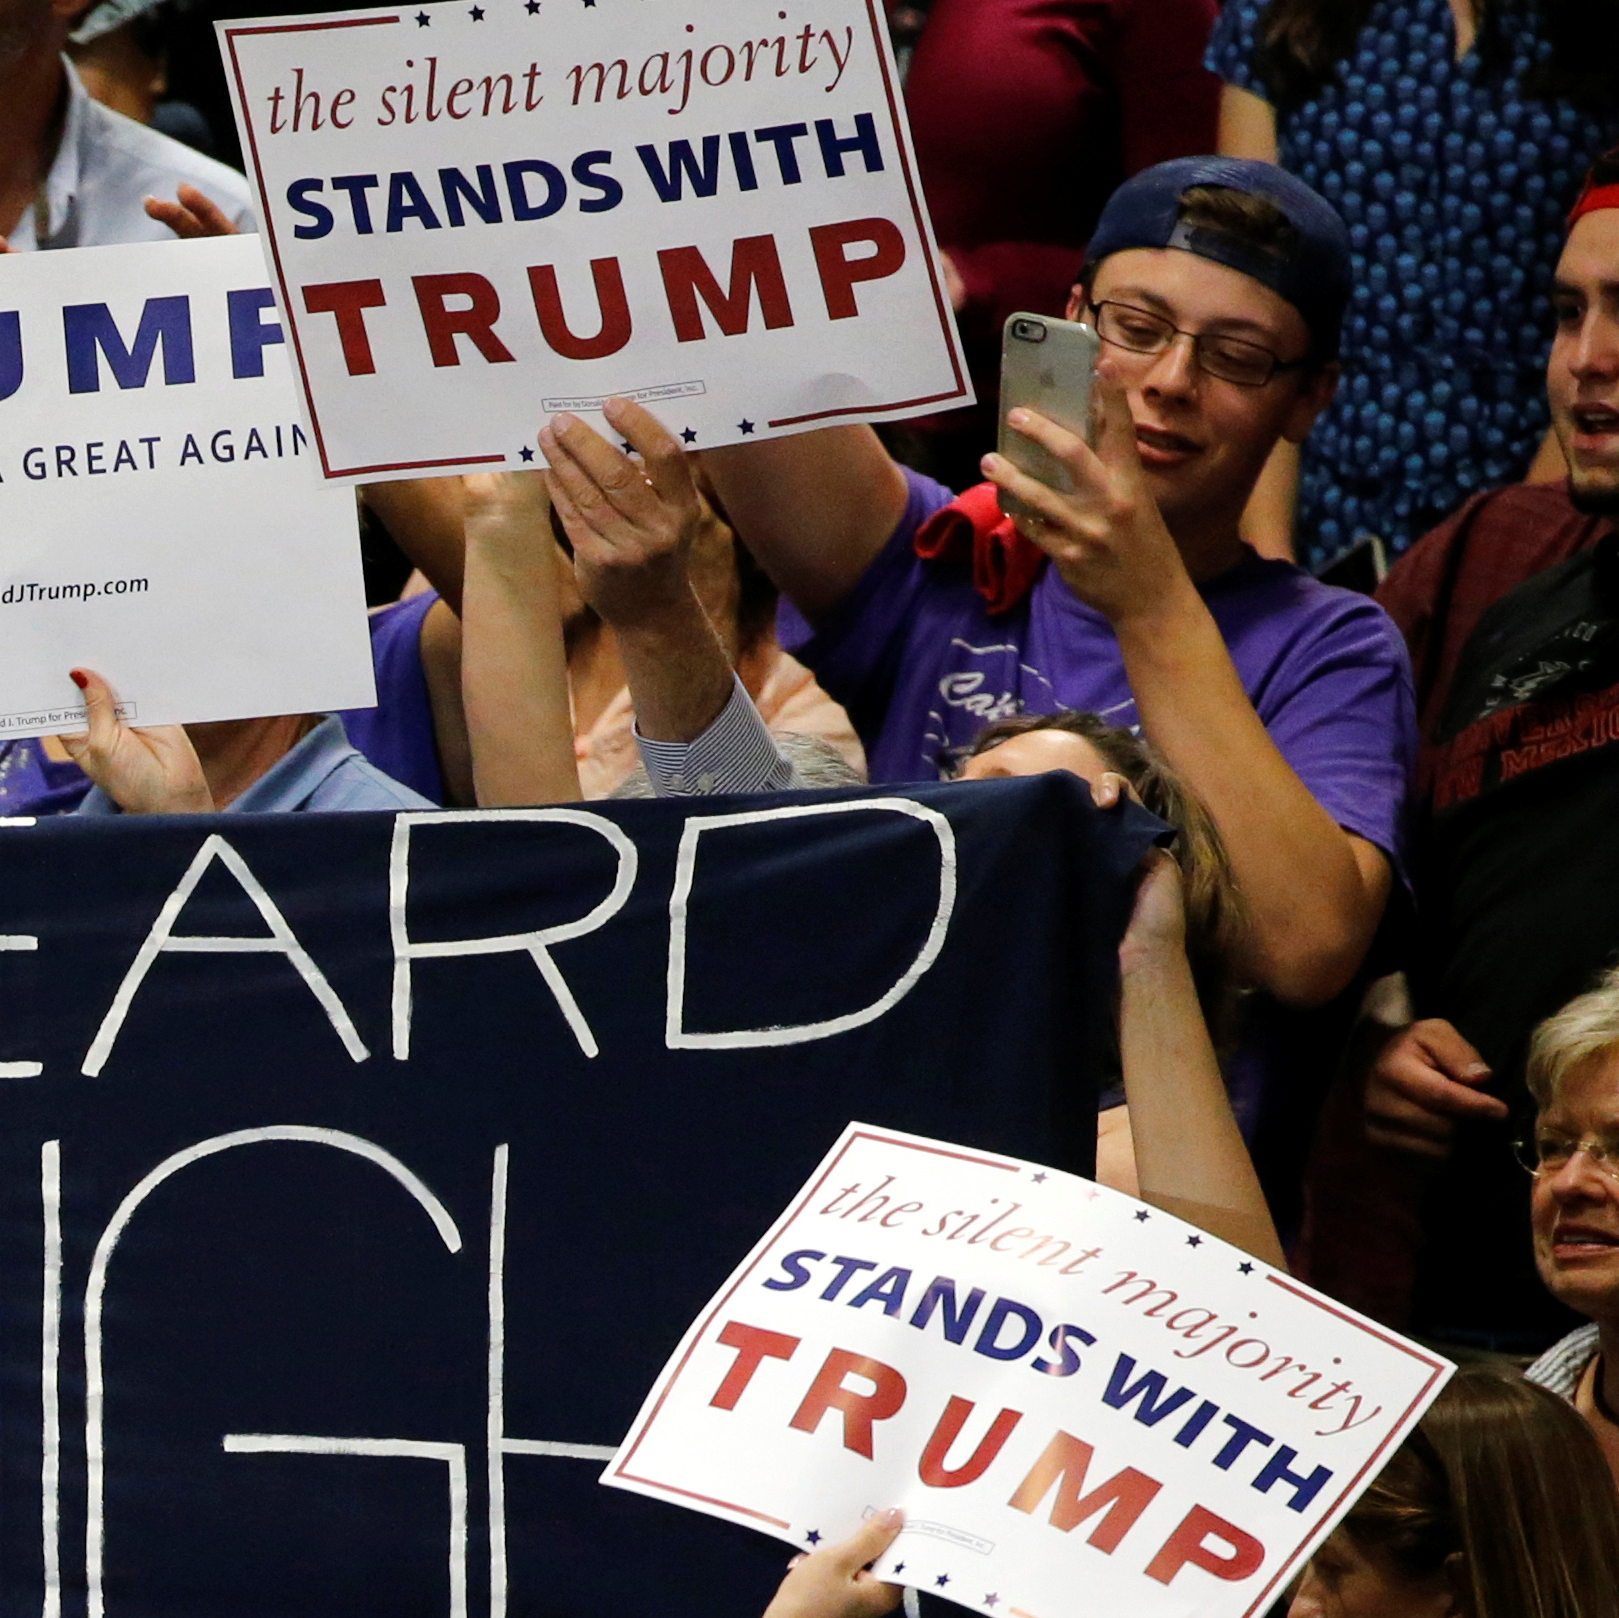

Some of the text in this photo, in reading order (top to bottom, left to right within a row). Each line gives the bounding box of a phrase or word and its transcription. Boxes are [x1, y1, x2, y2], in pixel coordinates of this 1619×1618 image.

[268, 10, 854, 135] the silent majority
[286, 111, 886, 241] STANDS WITH
[301, 216, 907, 376] TRUMP
[22, 436, 161, 481] GREAT
[16, 714, 46, 728] Trump
[48, 712, 62, 723] for
[819, 1176, 1383, 1438] the silent majority
[763, 1248, 1334, 1513] STANDS WITH
[708, 1321, 1266, 1587] TRUMP
